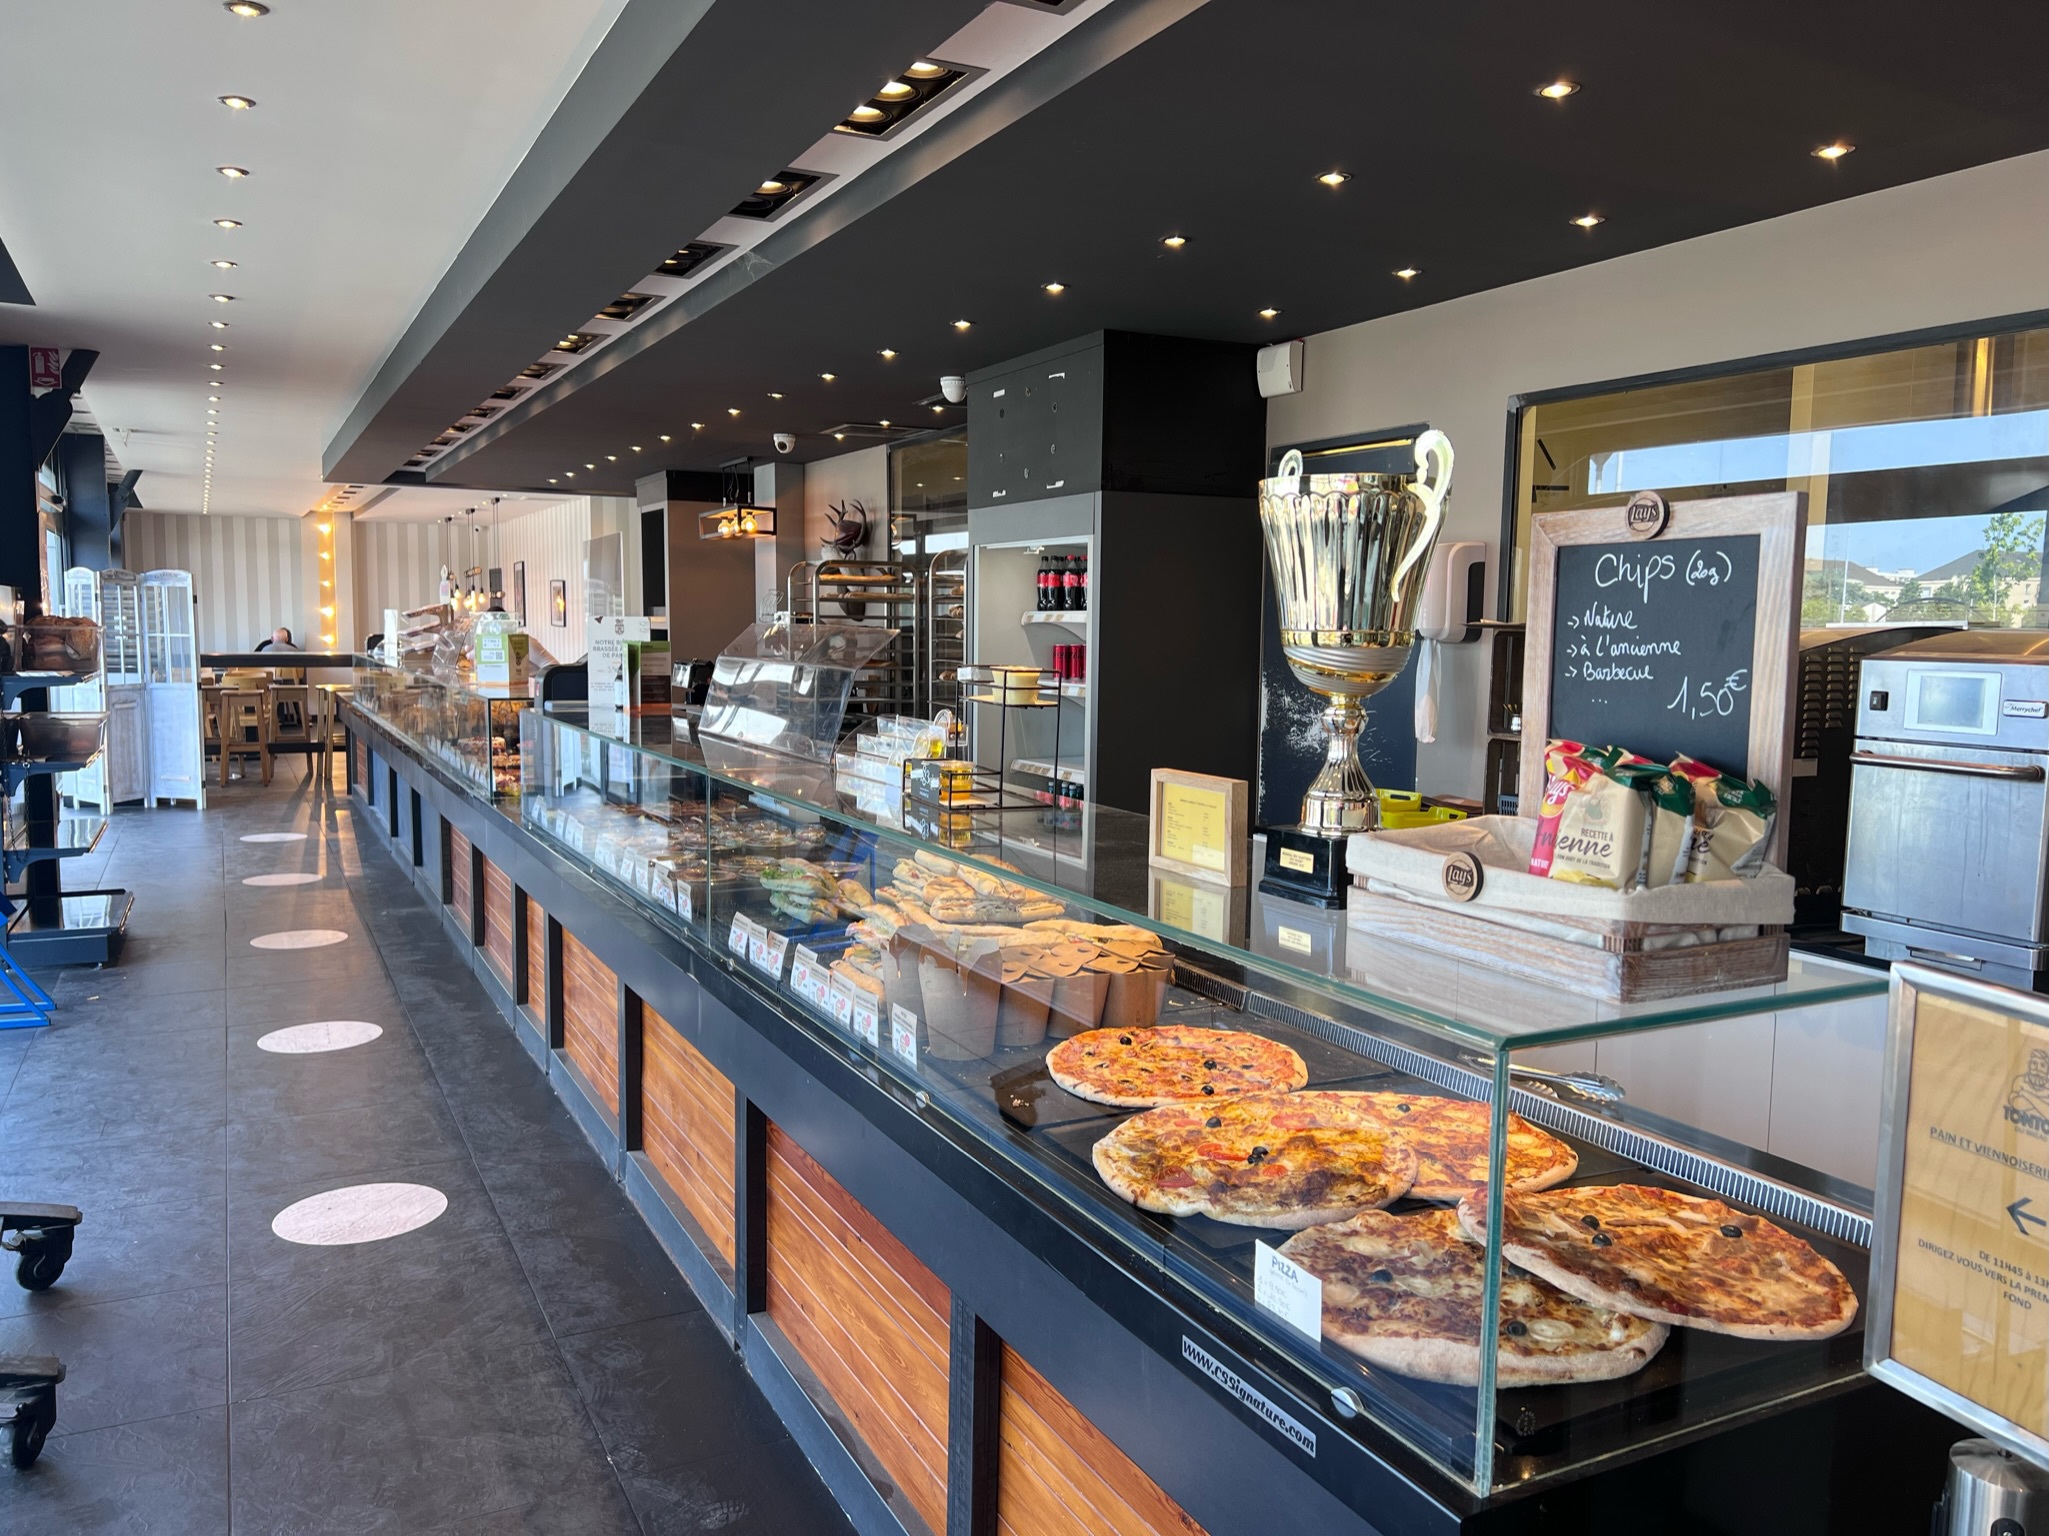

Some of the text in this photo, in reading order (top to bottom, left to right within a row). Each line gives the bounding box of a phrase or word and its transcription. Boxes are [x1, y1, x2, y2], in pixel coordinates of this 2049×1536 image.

[1595, 549, 1733, 604] Chips (20g)
[1583, 601, 1638, 629] Nature
[1580, 635, 1682, 658] à l'ancienne
[1583, 663, 1654, 681] Barbecue
[1666, 669, 1748, 720] 1,50€
[2010, 705, 2042, 714] Merrychef
[1580, 828, 1608, 842] RECETTE
[1930, 1126, 2049, 1179] PAIN ET VIENNOISERI
[1271, 1254, 1299, 1284] PIZZA
[1918, 1238, 1955, 1261] DIRIGEZ
[1957, 1255, 1983, 1273] VOUS
[1984, 1267, 2008, 1285] VERS
[2009, 1279, 2022, 1292] LA
[1979, 1250, 1991, 1263] DE
[1993, 1257, 2024, 1277] 11H45
[2003, 1290, 2032, 1310] FOND
[1183, 1340, 1315, 1453] www.cssignature.com
